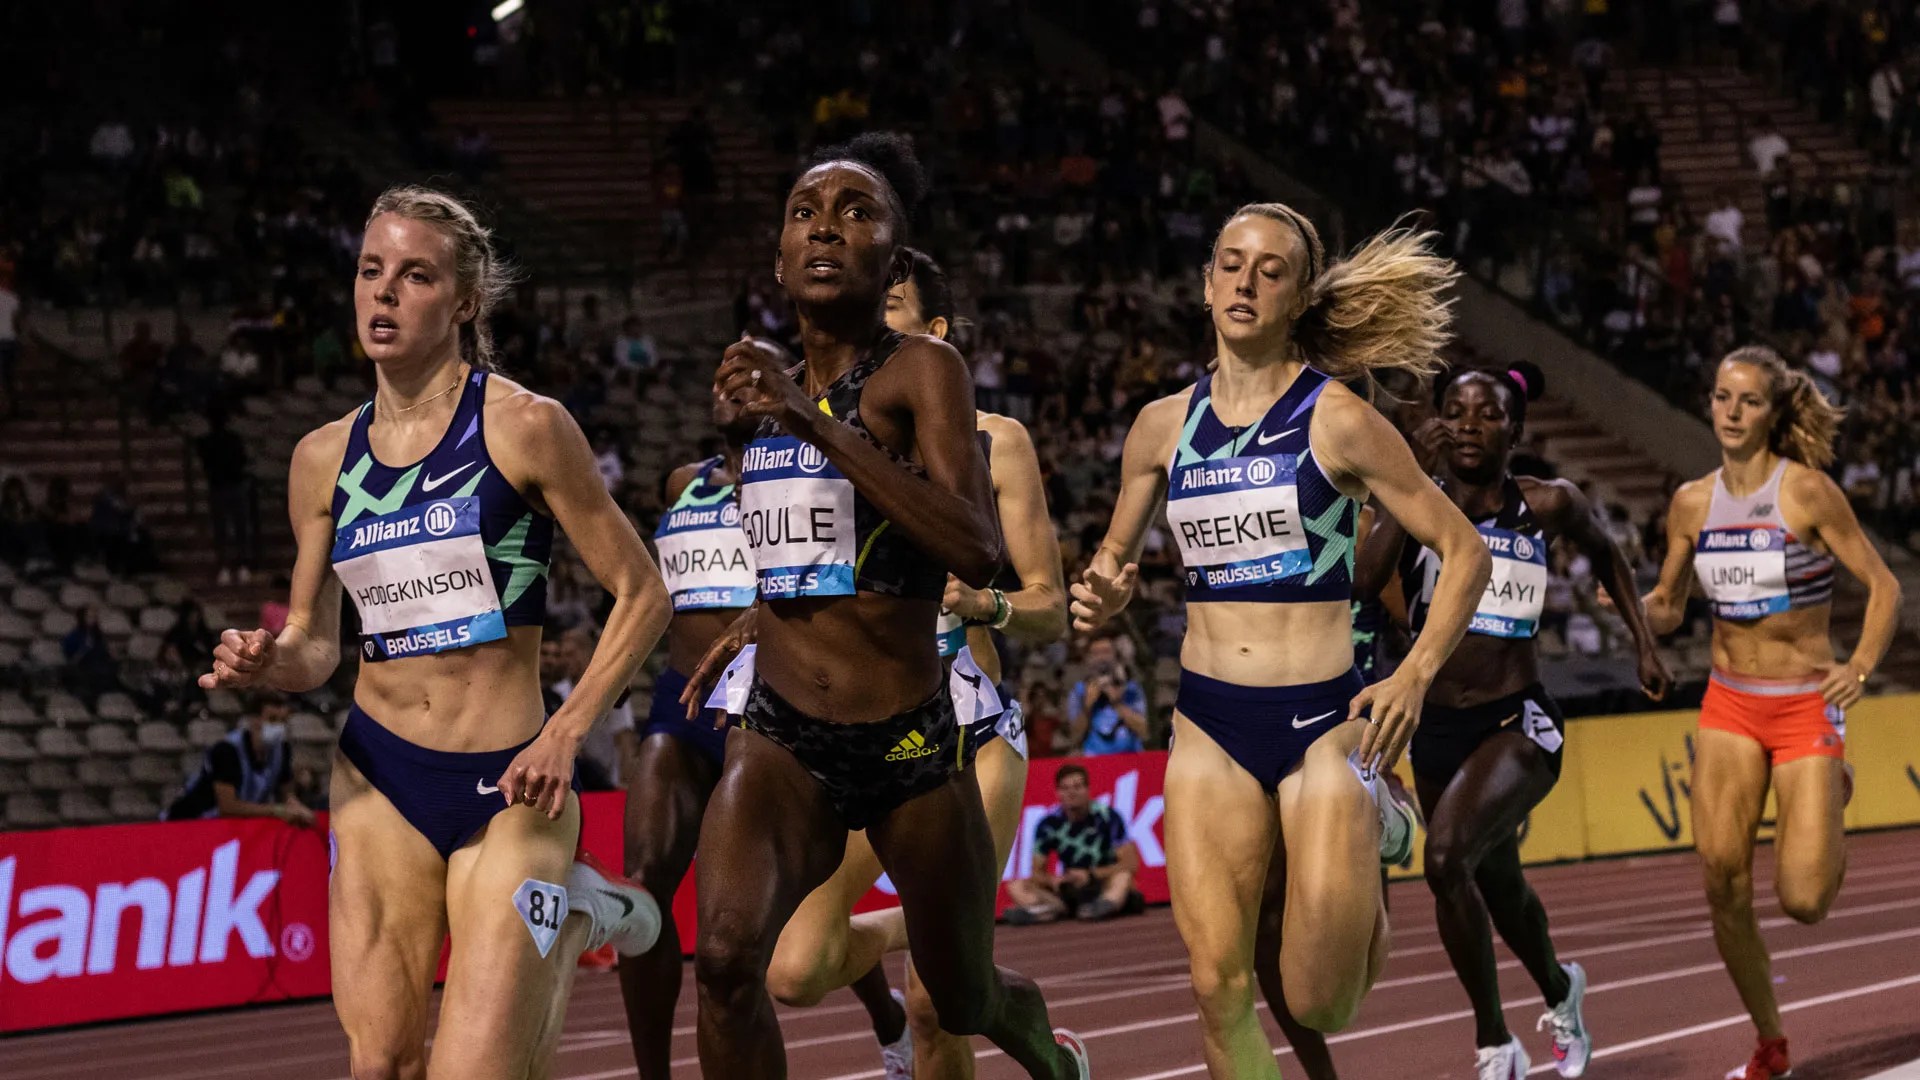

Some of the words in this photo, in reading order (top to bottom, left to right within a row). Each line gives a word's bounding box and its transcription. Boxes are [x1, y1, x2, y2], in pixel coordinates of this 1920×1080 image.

[742, 445, 795, 473] Allianz
[1181, 466, 1243, 490] Allianz
[349, 516, 420, 549] Allianz
[667, 510, 718, 531] Allianz
[742, 507, 836, 549] GOULE
[1180, 509, 1291, 549] REEKIE
[1705, 532, 1748, 549] Allianz
[664, 548, 748, 579] MORAA
[1207, 560, 1283, 586] BRUSSELS
[1711, 567, 1755, 585] LINDH
[356, 568, 484, 607] HODGKINSON
[761, 573, 819, 595] USSELS
[1486, 578, 1535, 603] AAYI
[385, 625, 471, 656] BRUSSELS
[885, 743, 940, 762] adidas
[529, 889, 560, 931] 8.1
